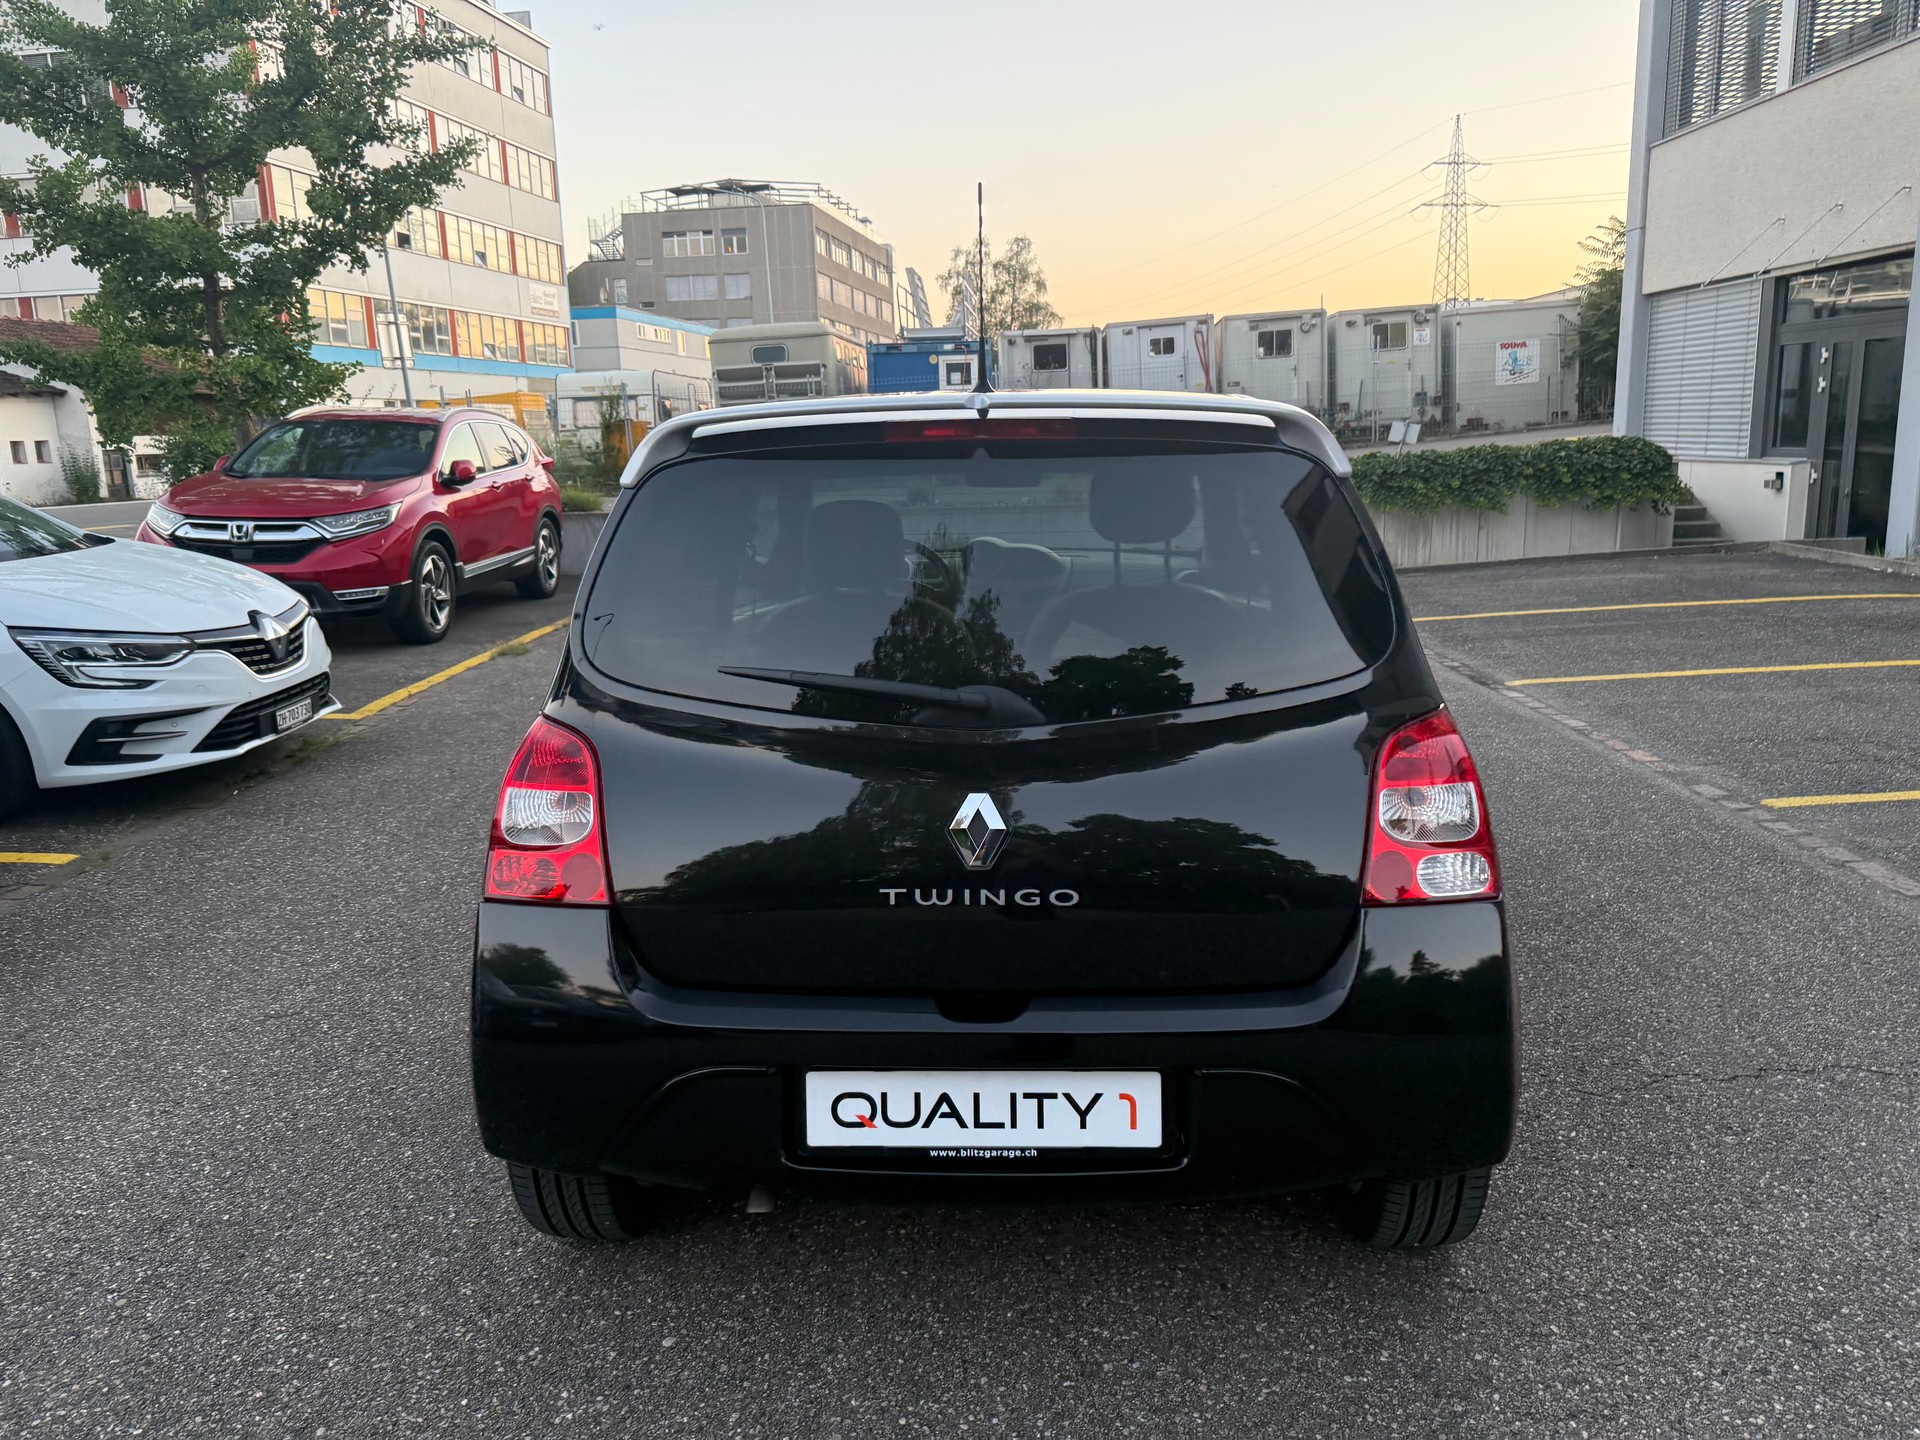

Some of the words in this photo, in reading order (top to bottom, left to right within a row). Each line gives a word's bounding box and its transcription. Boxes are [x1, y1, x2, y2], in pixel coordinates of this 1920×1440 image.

[879, 888, 1080, 906] TWINGO
[830, 1091, 1104, 1129] QUALITY
[929, 1148, 1038, 1158] www.blitzgarage.ch
